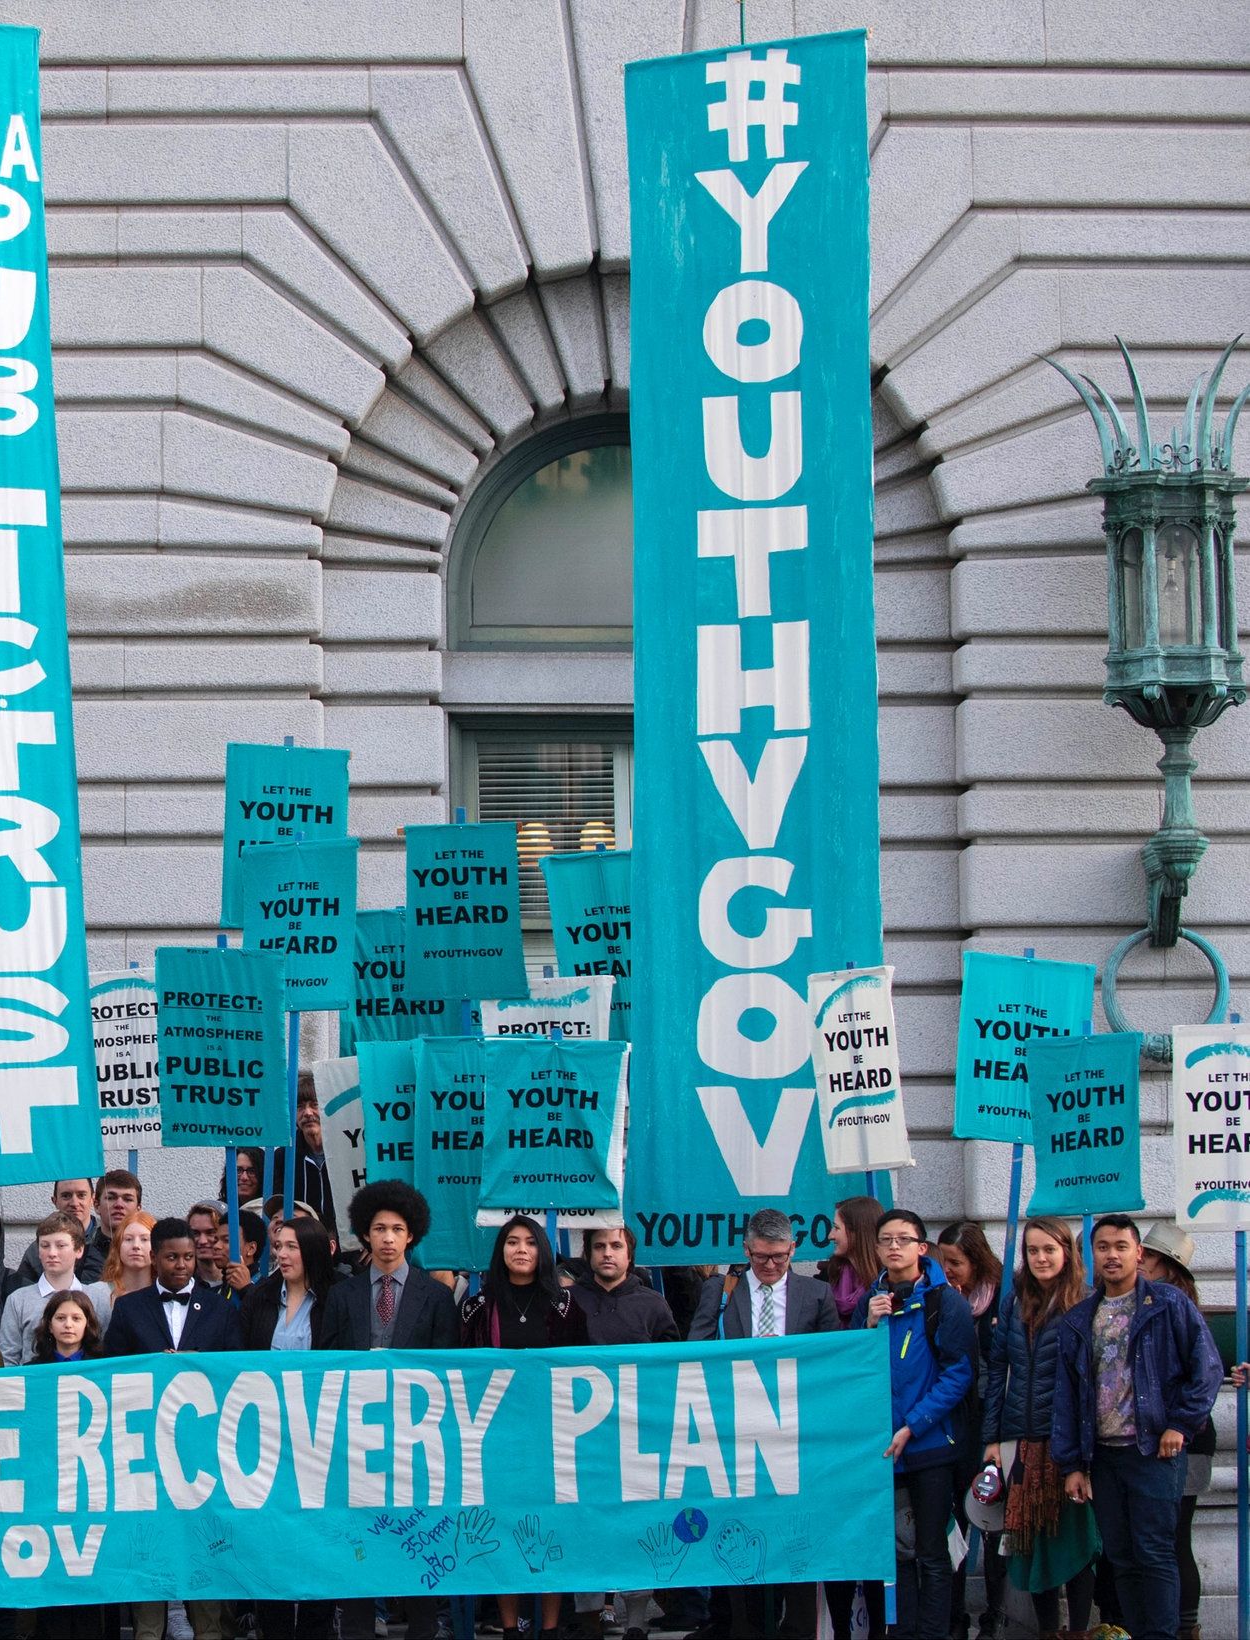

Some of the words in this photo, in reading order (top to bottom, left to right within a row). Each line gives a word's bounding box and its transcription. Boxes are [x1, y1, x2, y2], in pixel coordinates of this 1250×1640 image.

[0, 114, 40, 182] A
[262, 785, 284, 795] LET
[288, 786, 311, 796] THE
[239, 800, 333, 824] YOUTH
[278, 827, 293, 836] BE
[435, 850, 456, 860] LET
[460, 850, 484, 859] THE
[412, 866, 508, 888] YOUTH
[278, 882, 296, 892] LET
[298, 881, 320, 890] THE
[453, 891, 469, 899] BE
[259, 897, 340, 920] YOUTH
[416, 905, 509, 926] HEARD
[584, 906, 605, 916] LET
[607, 905, 631, 915] THE
[288, 921, 301, 930] BE
[374, 945, 396, 954] LET
[607, 945, 622, 954] BE
[163, 991, 263, 1012] PROTECT:
[355, 998, 445, 1017] HEARD
[91, 1002, 159, 1020] ROTECT
[838, 1013, 854, 1023] LET
[854, 1011, 871, 1021] THE
[998, 1003, 1021, 1014] LET
[1024, 1004, 1048, 1019] THE
[164, 1026, 264, 1041] ATMOSPHERE
[824, 1026, 889, 1052] YOUTH
[166, 1056, 264, 1079] PUBLIC
[853, 1055, 863, 1065] BE
[453, 1074, 476, 1083] LET
[531, 1070, 552, 1081] LET
[556, 1070, 577, 1081] THE
[829, 1067, 892, 1093] HEARD
[1064, 1072, 1081, 1083] LET
[1084, 1069, 1105, 1080] THE
[1208, 1073, 1229, 1083] LET
[171, 1084, 260, 1107] TRUST
[507, 1088, 599, 1111] YOUTH
[1046, 1084, 1125, 1113] YOUTH
[547, 1112, 562, 1121] BE
[1077, 1113, 1091, 1123] BE
[1226, 1117, 1241, 1126] BE
[508, 1128, 594, 1150] HEARD
[1051, 1125, 1125, 1154] HEARD
[56, 1369, 516, 1513] RECOVERY
[550, 1358, 800, 1504] PLAN
[420, 1555, 456, 1590] 2100
